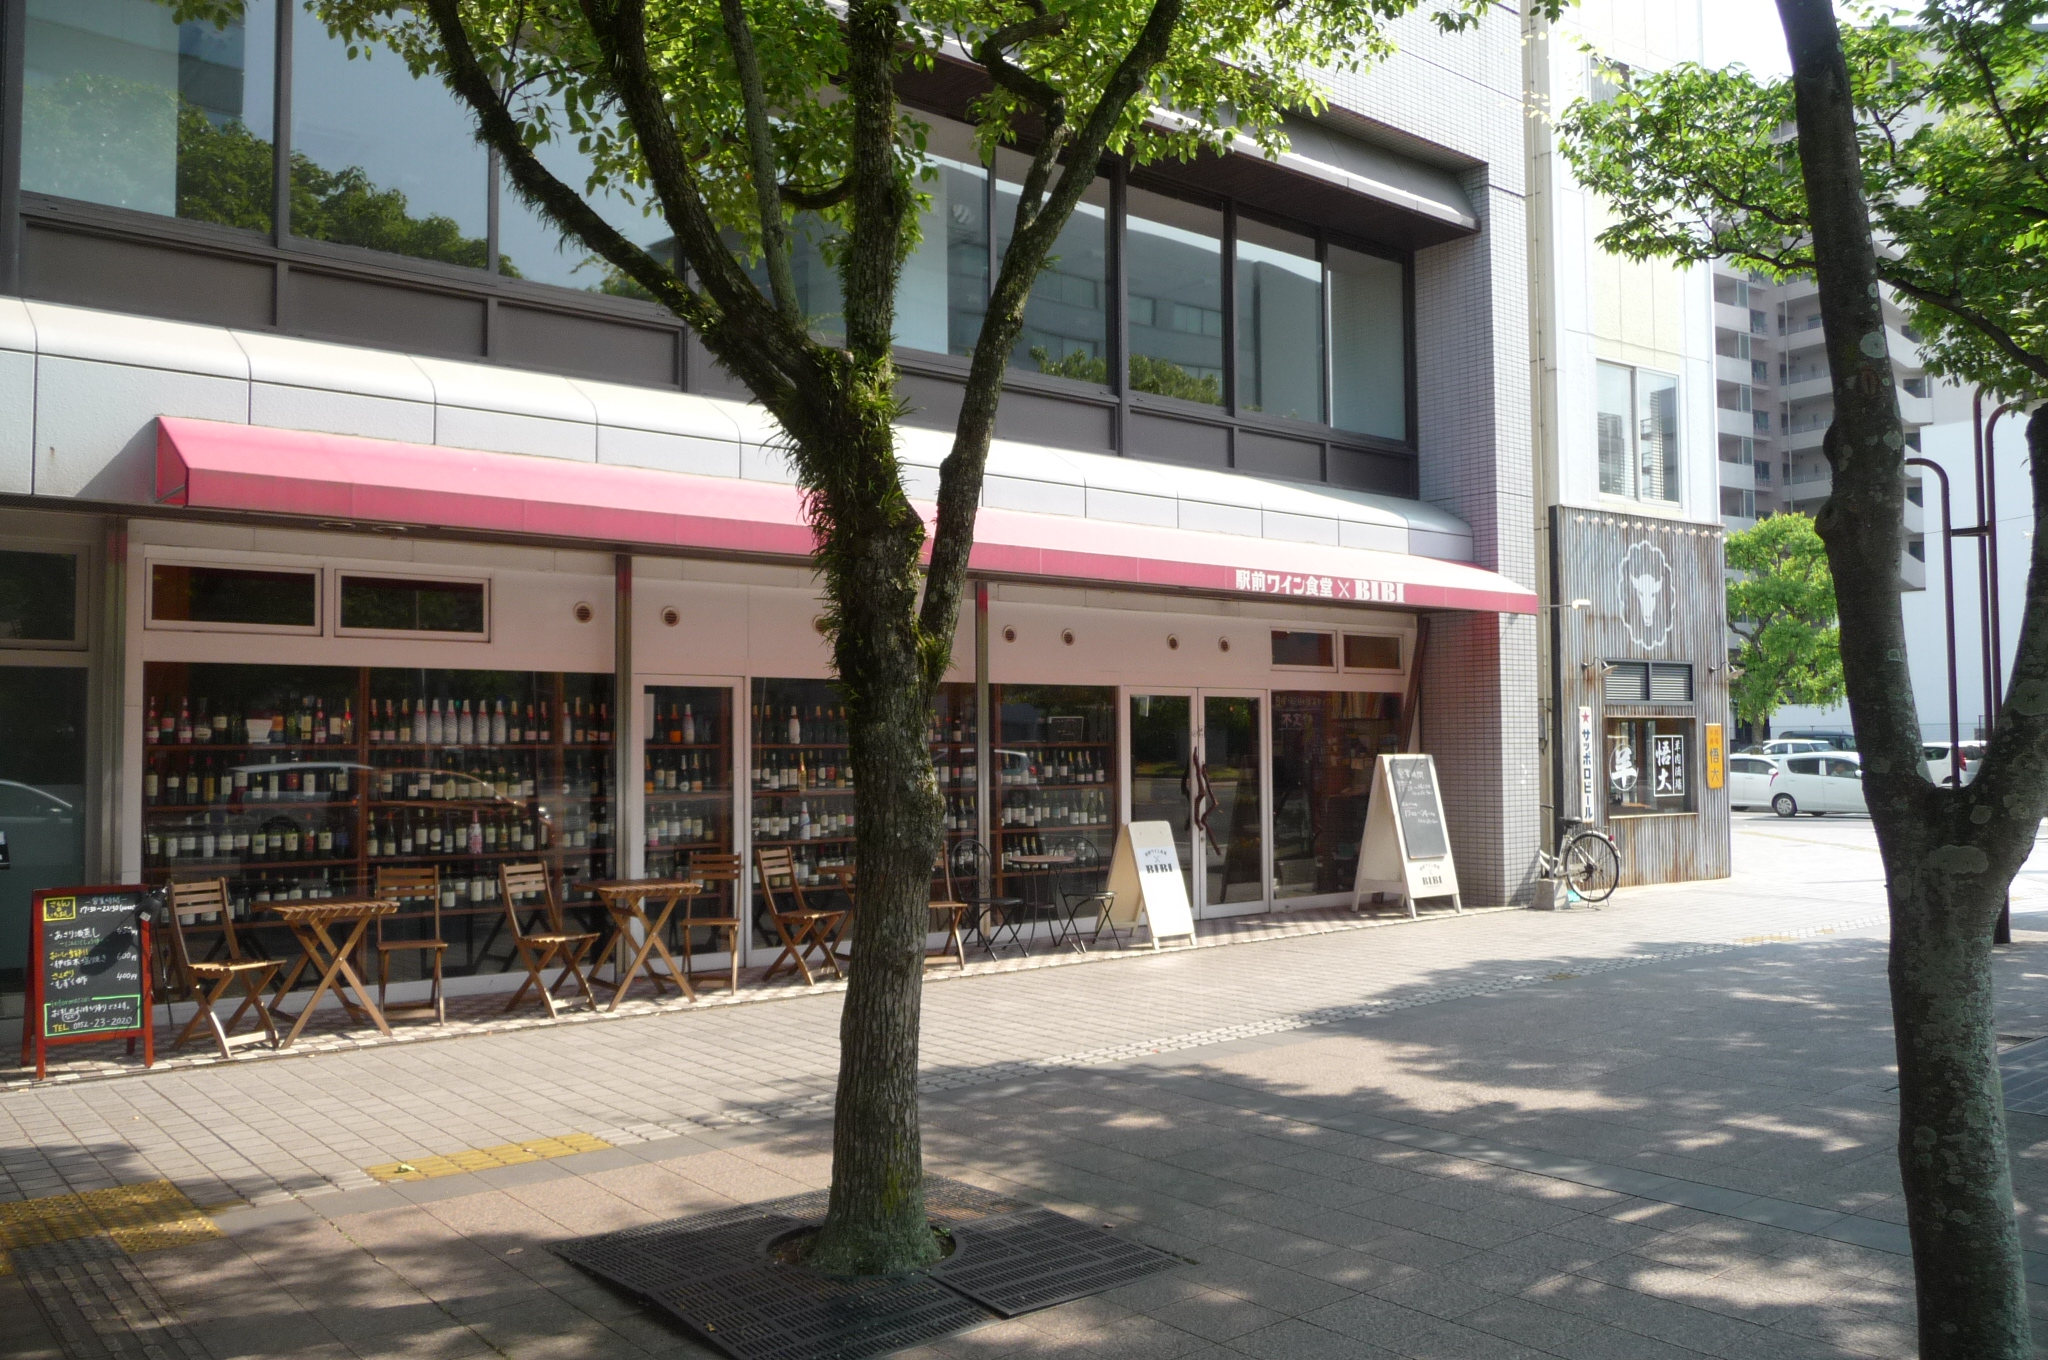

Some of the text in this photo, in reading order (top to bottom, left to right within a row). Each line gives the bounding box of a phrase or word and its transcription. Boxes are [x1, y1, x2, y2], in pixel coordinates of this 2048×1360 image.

[1235, 569, 1406, 603] 駅前ワイン食堂 BIBI
[1582, 729, 1592, 819] サッポロビール
[1611, 747, 1638, 788] 羊
[1655, 740, 1672, 791] 悟大
[1710, 748, 1720, 782] 悟大
[1145, 863, 1173, 874] BIBI
[1422, 876, 1443, 886] BIBI
[52, 1023, 69, 1032] TEL
